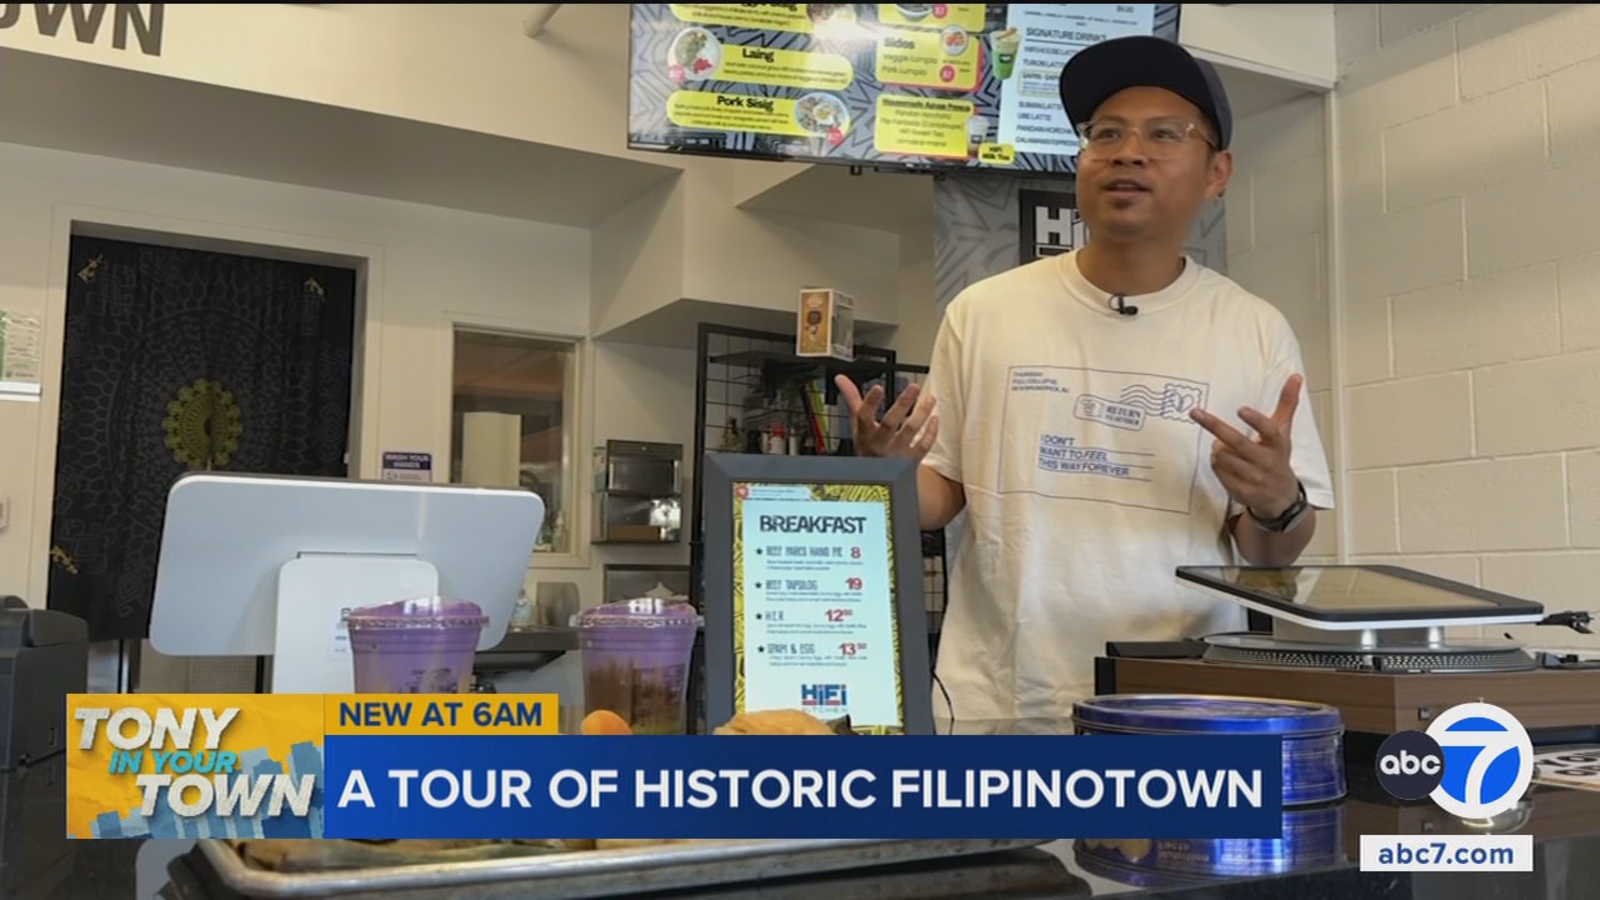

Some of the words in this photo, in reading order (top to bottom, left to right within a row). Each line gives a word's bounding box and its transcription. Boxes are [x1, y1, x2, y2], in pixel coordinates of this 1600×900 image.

[742, 47, 774, 62] Laing
[717, 95, 743, 107] Pork
[746, 98, 774, 112] Sisig
[1044, 434, 1076, 446] DON'T
[1040, 446, 1067, 458] WANT
[1069, 449, 1083, 460] TO
[1083, 450, 1108, 461] FEEL
[1039, 457, 1058, 470] THIS
[1060, 461, 1081, 471] WAY
[1081, 462, 1130, 477] FOREVER
[759, 514, 867, 534] BREAKFAST
[850, 545, 862, 559] 8
[845, 577, 863, 591] 19
[801, 683, 848, 706] HiFi
